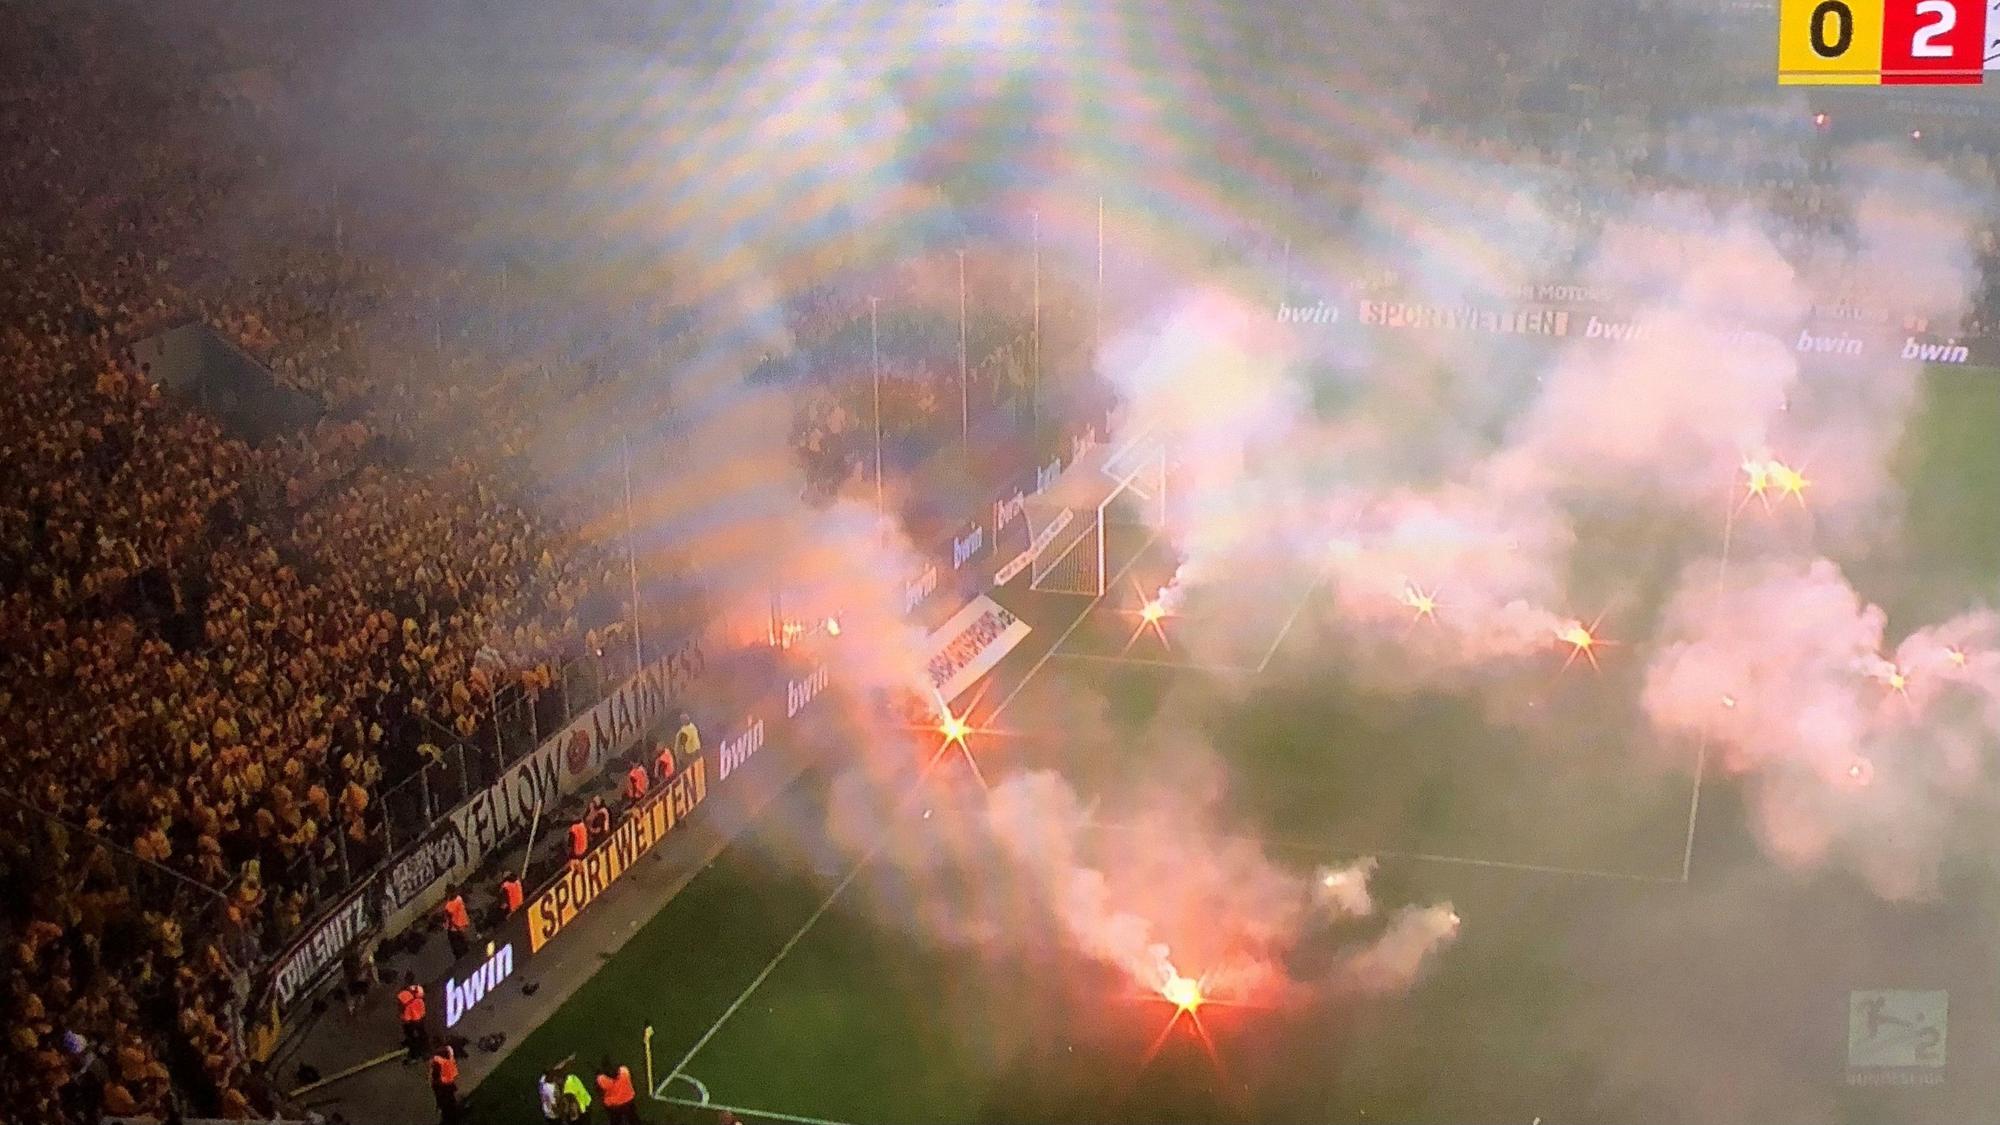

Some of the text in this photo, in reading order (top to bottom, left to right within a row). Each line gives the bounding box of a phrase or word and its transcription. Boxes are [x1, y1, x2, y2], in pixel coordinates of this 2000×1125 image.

[1276, 301, 1340, 325] bwin
[1796, 329, 1863, 355] bwin
[1901, 337, 1969, 363] bwin
[786, 665, 829, 718] bwin
[719, 716, 764, 782] bwin
[449, 738, 563, 872] YELLOW
[539, 762, 702, 939] SPORTWETTEN
[446, 941, 514, 1029] bwin
